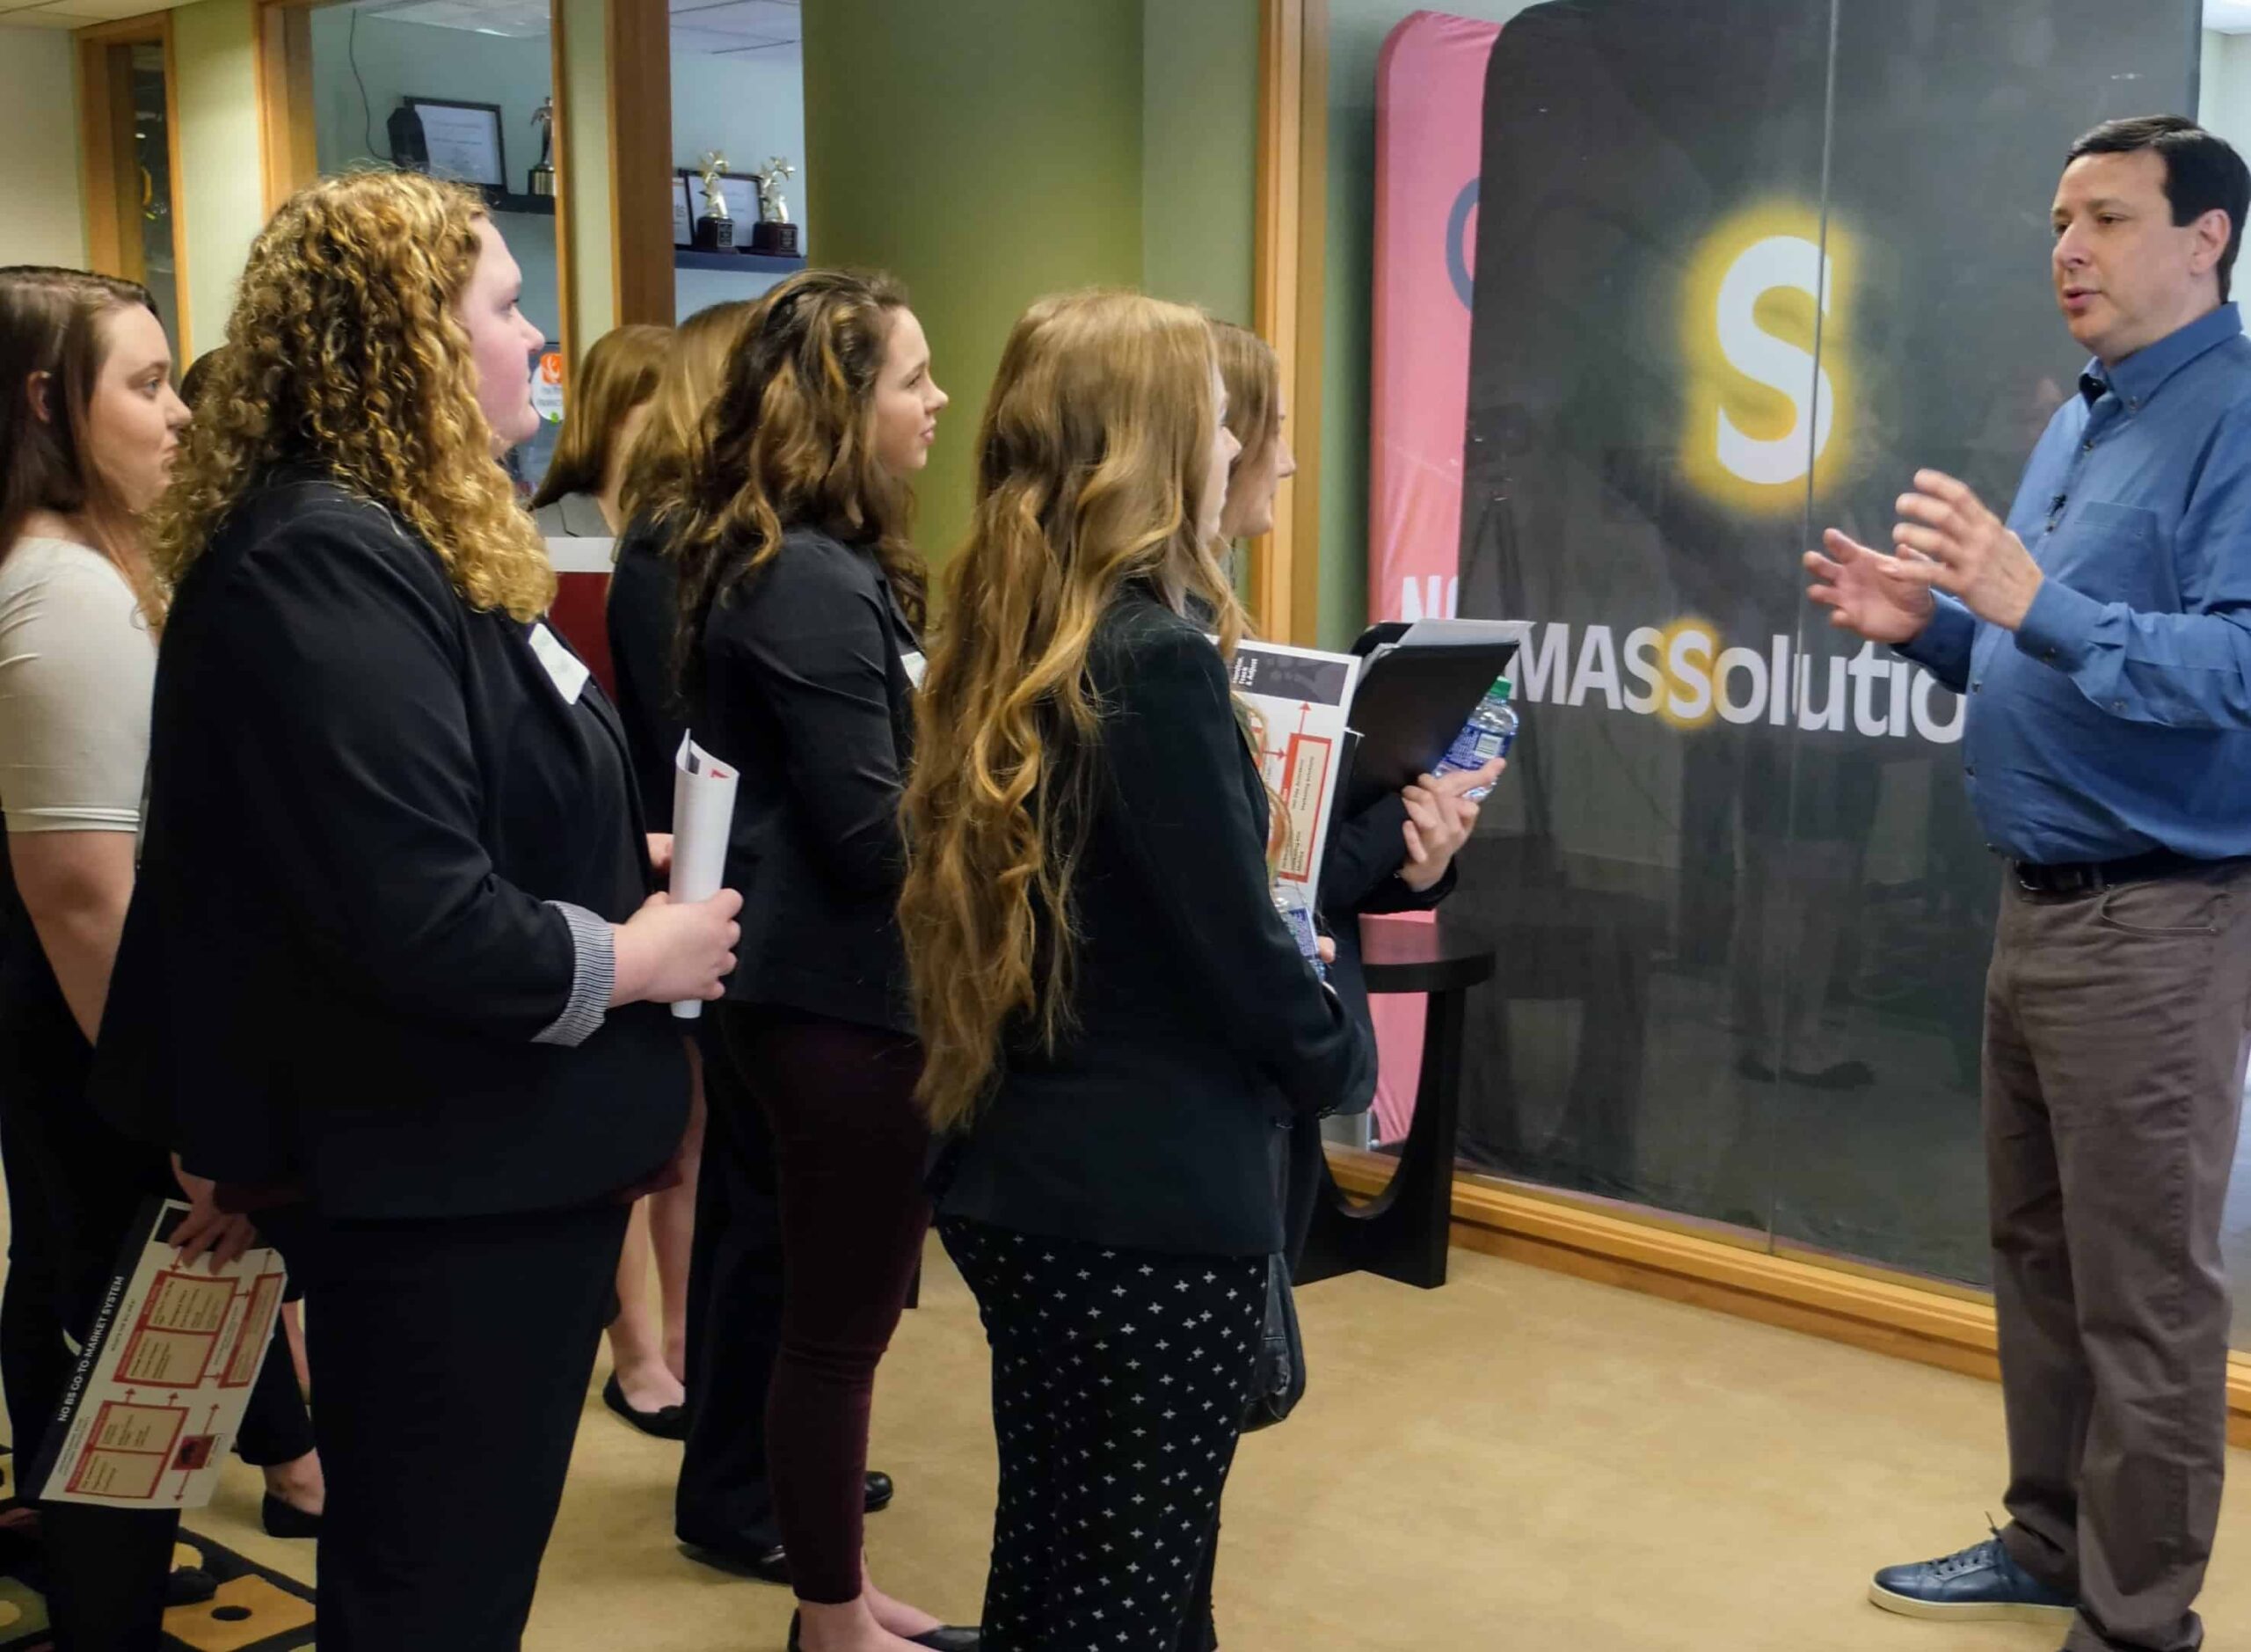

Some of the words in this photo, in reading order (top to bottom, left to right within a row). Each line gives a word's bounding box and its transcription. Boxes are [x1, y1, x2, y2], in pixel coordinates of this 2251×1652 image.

[1716, 235, 1834, 484] S
[57, 1406, 70, 1422] NO
[64, 1391, 77, 1405] BS
[103, 1277, 125, 1315] SYSTEM
